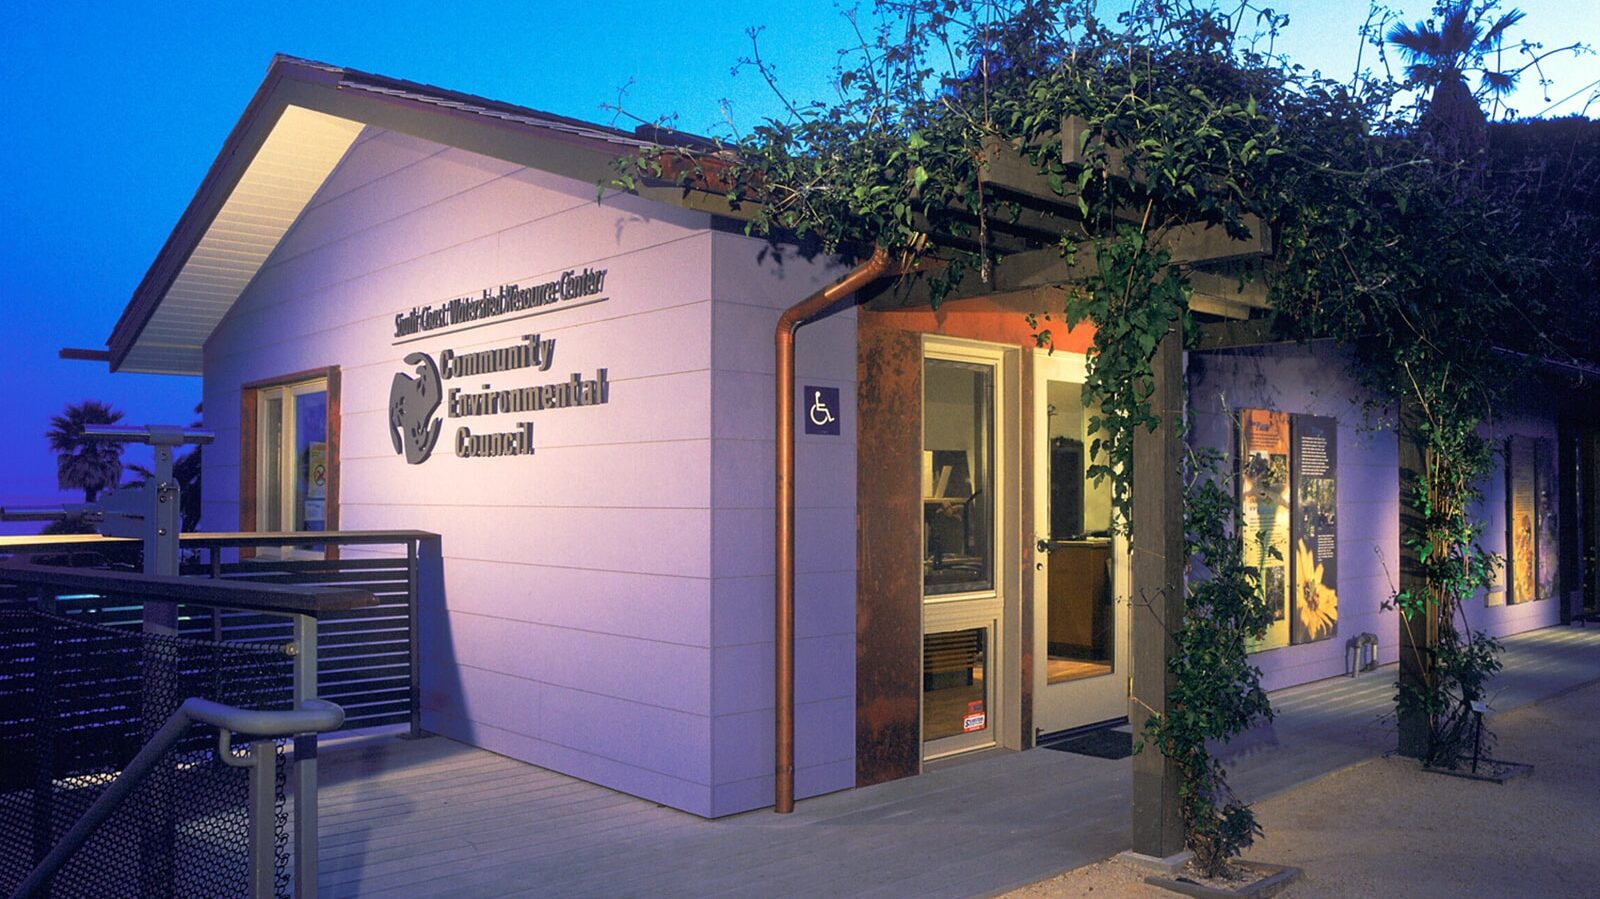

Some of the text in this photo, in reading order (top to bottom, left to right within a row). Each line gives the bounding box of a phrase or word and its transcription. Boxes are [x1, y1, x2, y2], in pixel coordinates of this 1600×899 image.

[449, 285, 505, 325] Watershed
[505, 280, 560, 313] Resource
[560, 268, 608, 301] Center
[440, 333, 556, 380] Community
[448, 368, 609, 418] Environmental
[455, 421, 535, 458] Council
